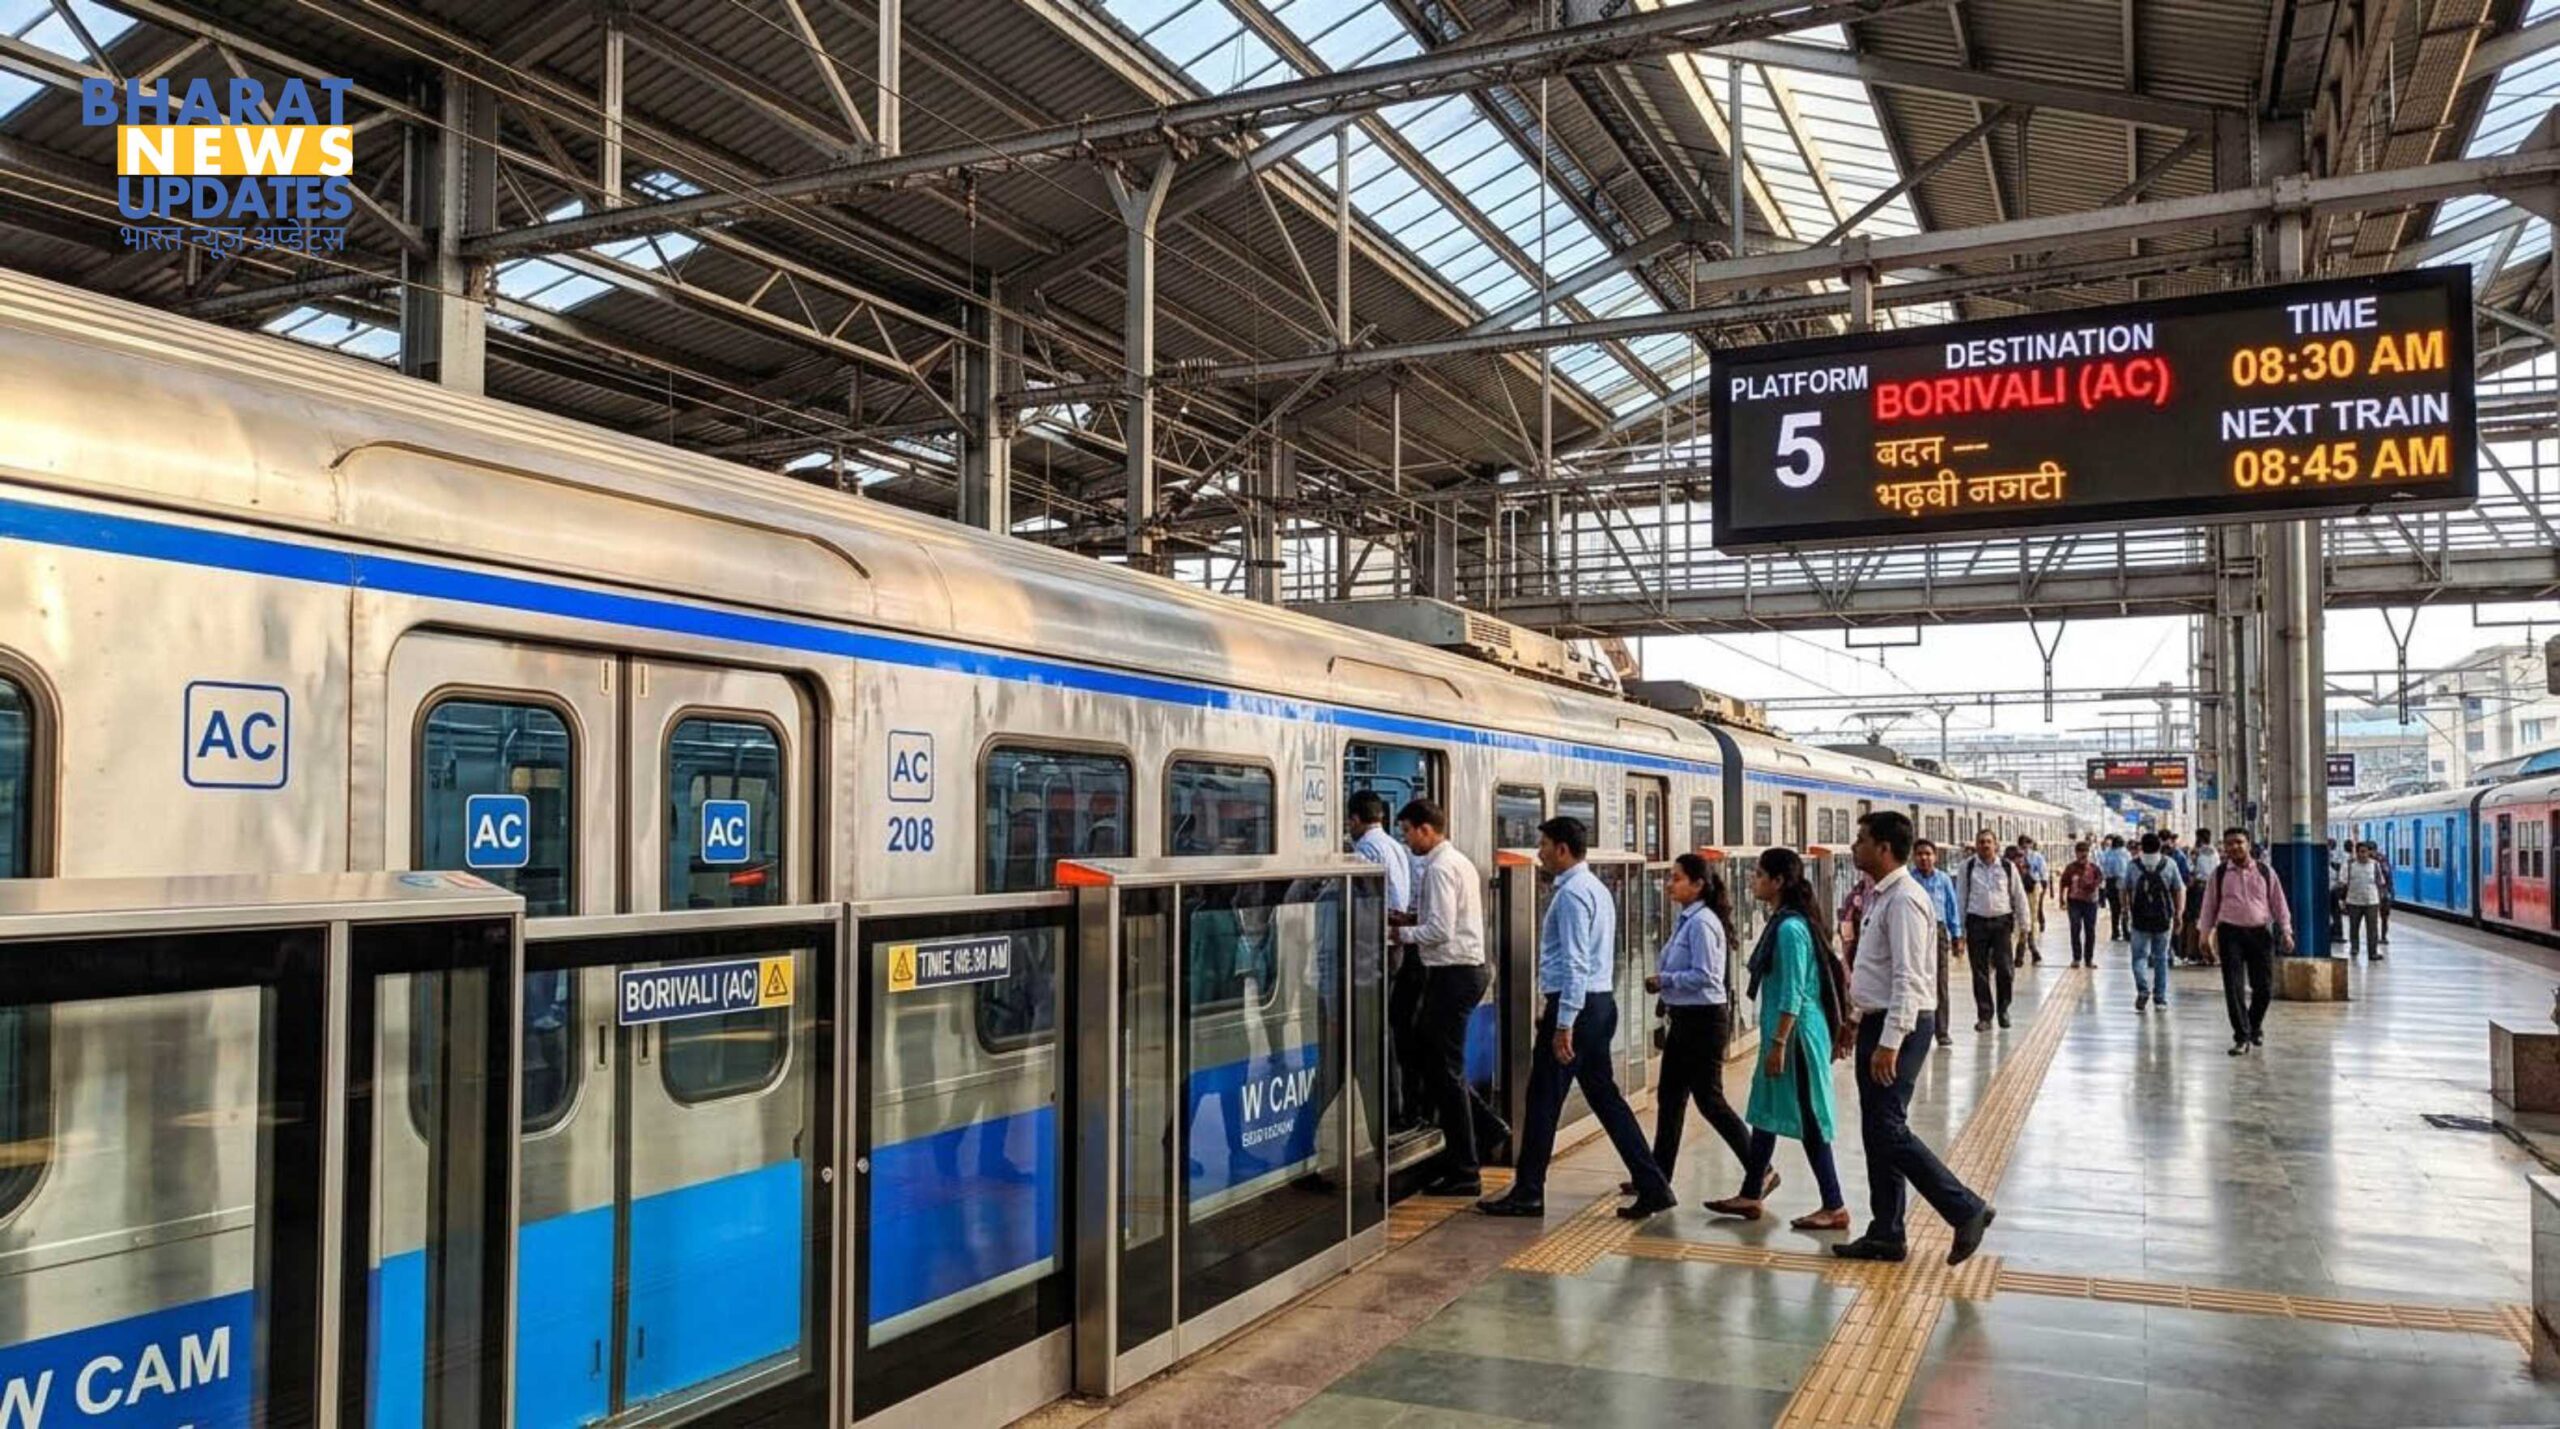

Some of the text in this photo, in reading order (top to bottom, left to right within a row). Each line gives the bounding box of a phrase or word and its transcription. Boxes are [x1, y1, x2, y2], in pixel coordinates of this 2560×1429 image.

[2286, 297, 2378, 335] TIME
[1946, 322, 2154, 370] DESTINATION
[2231, 330, 2445, 388] 08:30 AM
[1730, 366, 1868, 402] PLATFORM
[1876, 357, 2171, 420] BORIVALI (AC)
[2221, 392, 2449, 441] NEXT TRAIN
[1775, 411, 1825, 488] 5
[2233, 435, 2448, 488] 08:45 AM
[197, 710, 276, 760] AC
[893, 750, 929, 783] AC
[473, 814, 522, 849] AC
[706, 816, 744, 847] AC
[888, 816, 933, 851] 208
[626, 967, 758, 1013] BORIVALI (AC)
[75, 1325, 230, 1415] CAM
